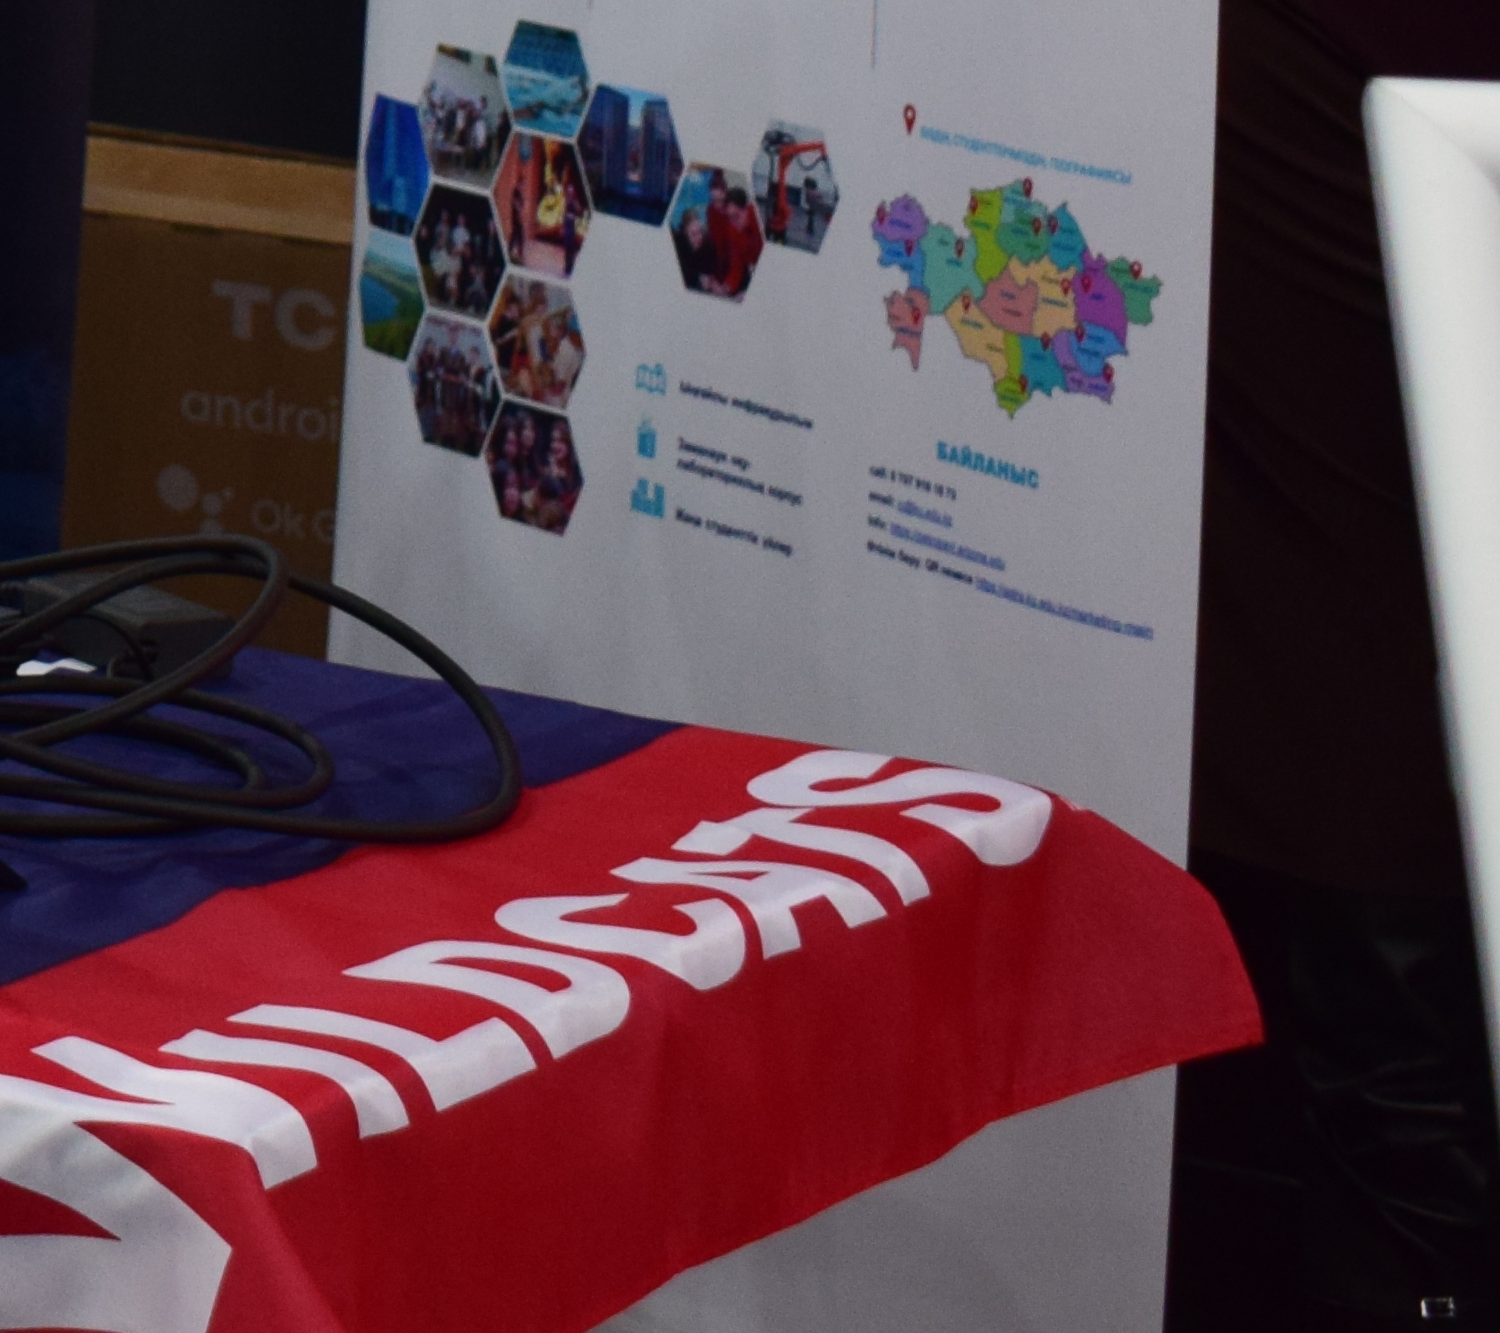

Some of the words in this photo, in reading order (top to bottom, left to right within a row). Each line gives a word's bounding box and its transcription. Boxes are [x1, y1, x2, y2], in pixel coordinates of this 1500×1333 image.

[210, 277, 338, 352] TC
[178, 384, 338, 444] androi
[936, 439, 1041, 490] БАЙЛАНЫС
